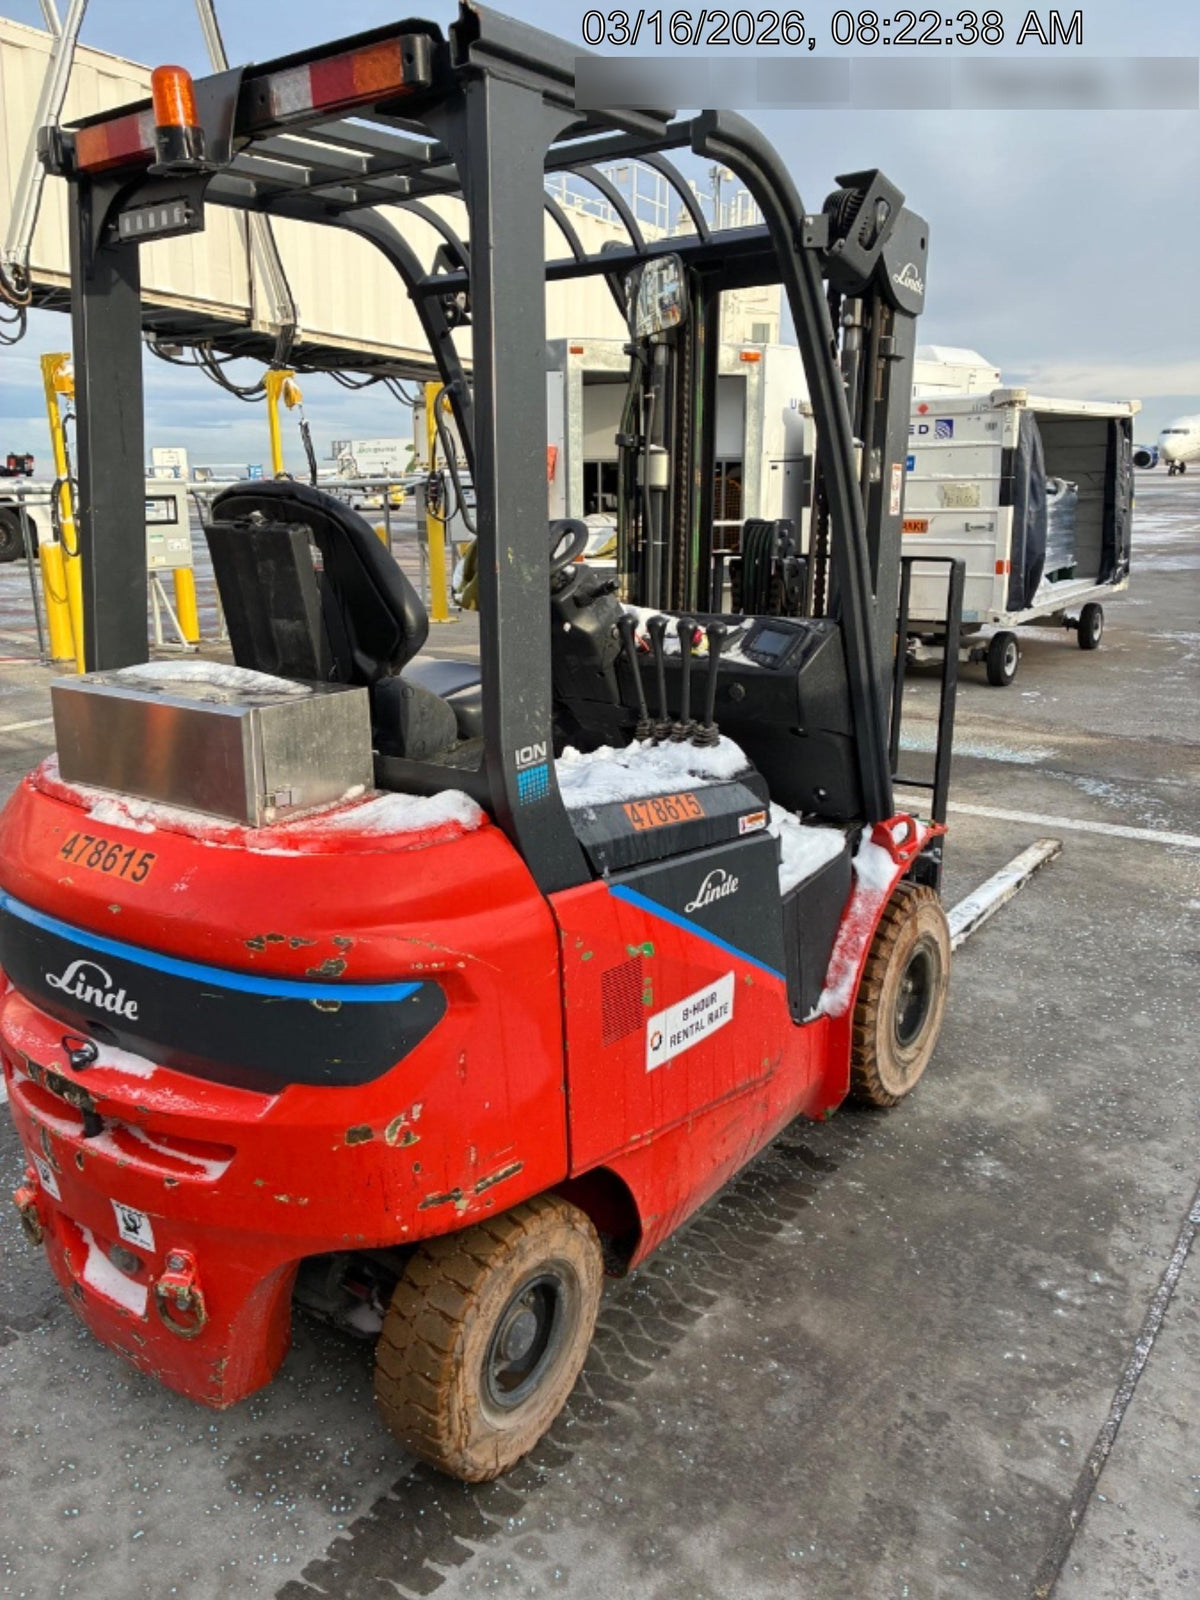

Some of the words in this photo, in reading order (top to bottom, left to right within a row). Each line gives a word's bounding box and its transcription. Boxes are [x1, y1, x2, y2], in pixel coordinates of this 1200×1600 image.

[893, 262, 924, 296] Linde
[515, 741, 547, 765] ION
[629, 794, 702, 828] 478615
[61, 833, 155, 882] 478615
[684, 868, 739, 913] Linde
[46, 959, 139, 1021] Linde
[682, 991, 718, 1021] 8-HOUR
[669, 1019, 705, 1048] RENTAL
[707, 1002, 729, 1025] RATE
